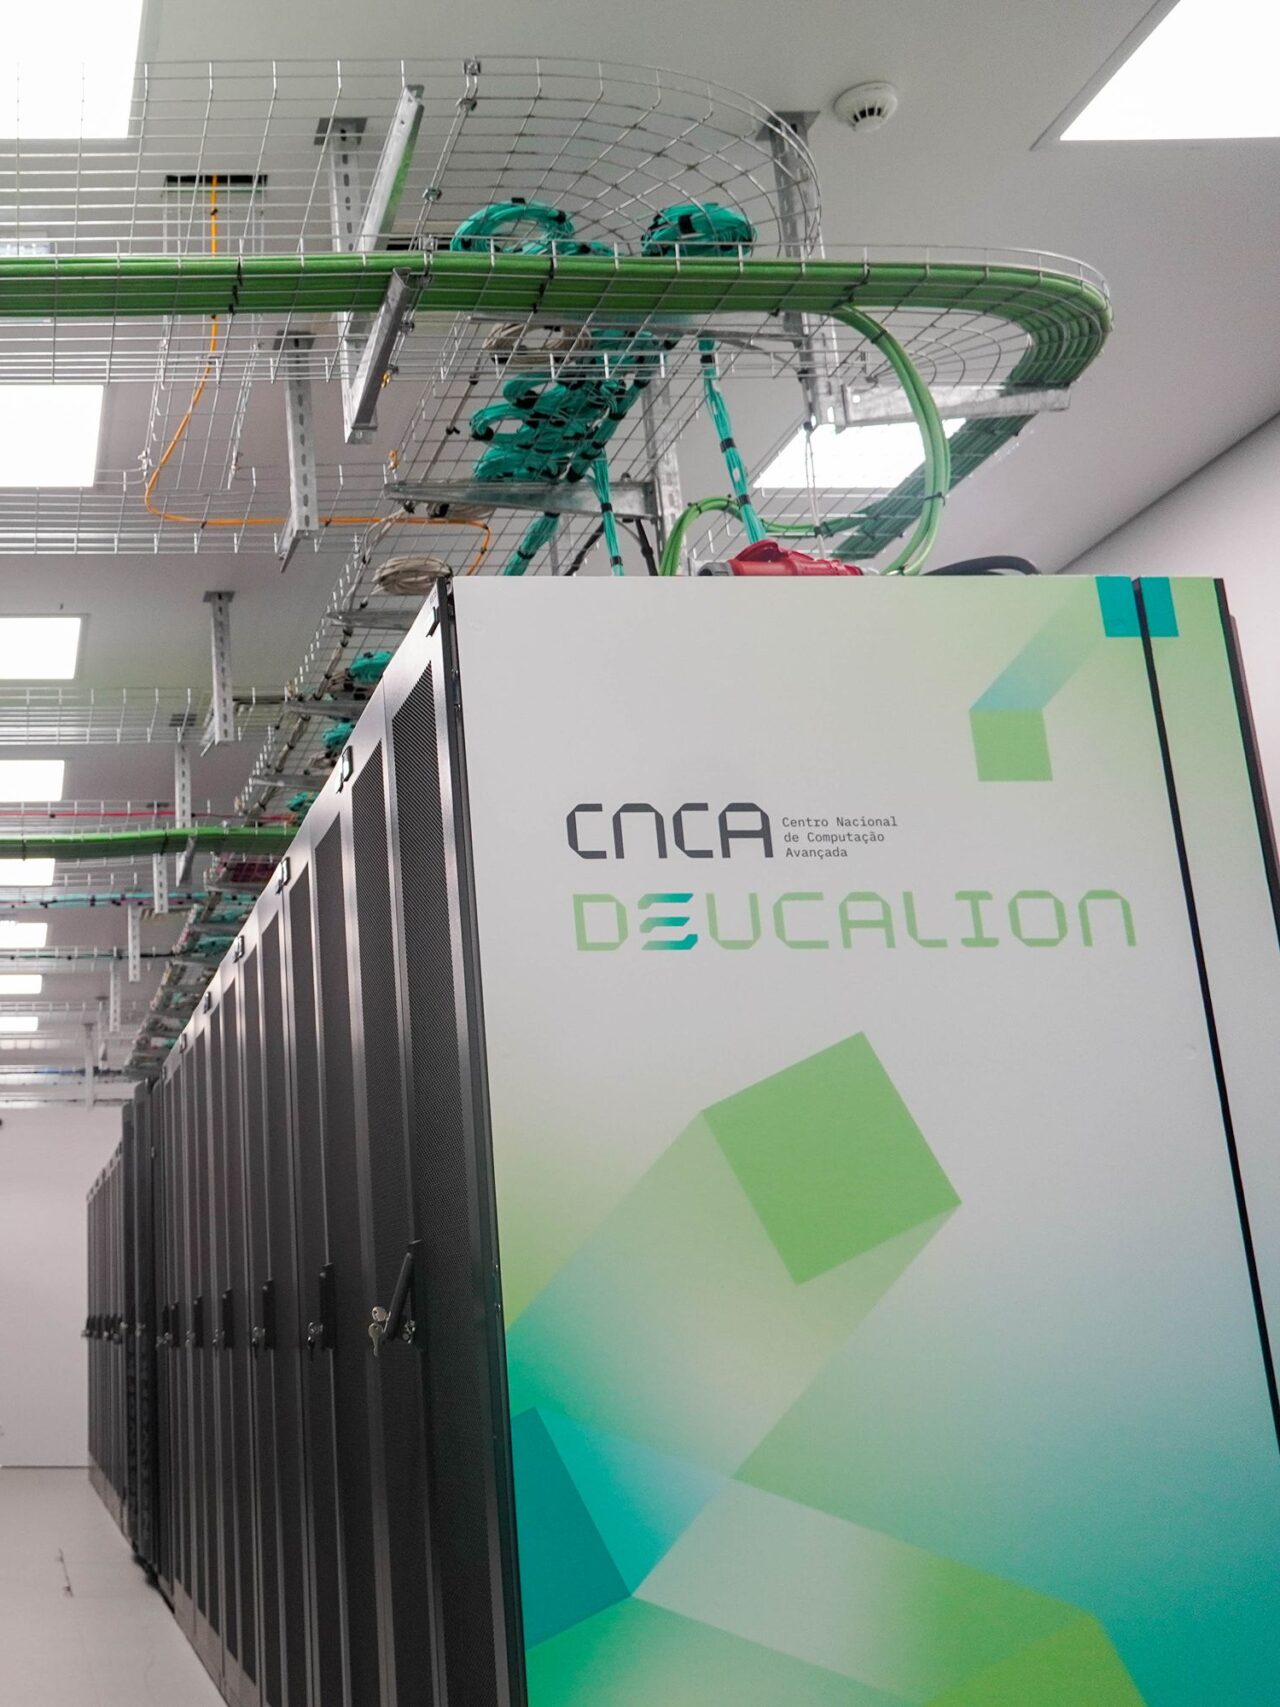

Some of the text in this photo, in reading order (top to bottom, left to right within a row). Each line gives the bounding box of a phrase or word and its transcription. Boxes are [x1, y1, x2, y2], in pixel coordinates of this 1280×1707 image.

[782, 816, 898, 827] Centro Nacional
[566, 802, 774, 859] CNCA
[783, 831, 885, 844] de Computação
[785, 846, 848, 859] Avançada
[573, 889, 1137, 951] DEUCALION
